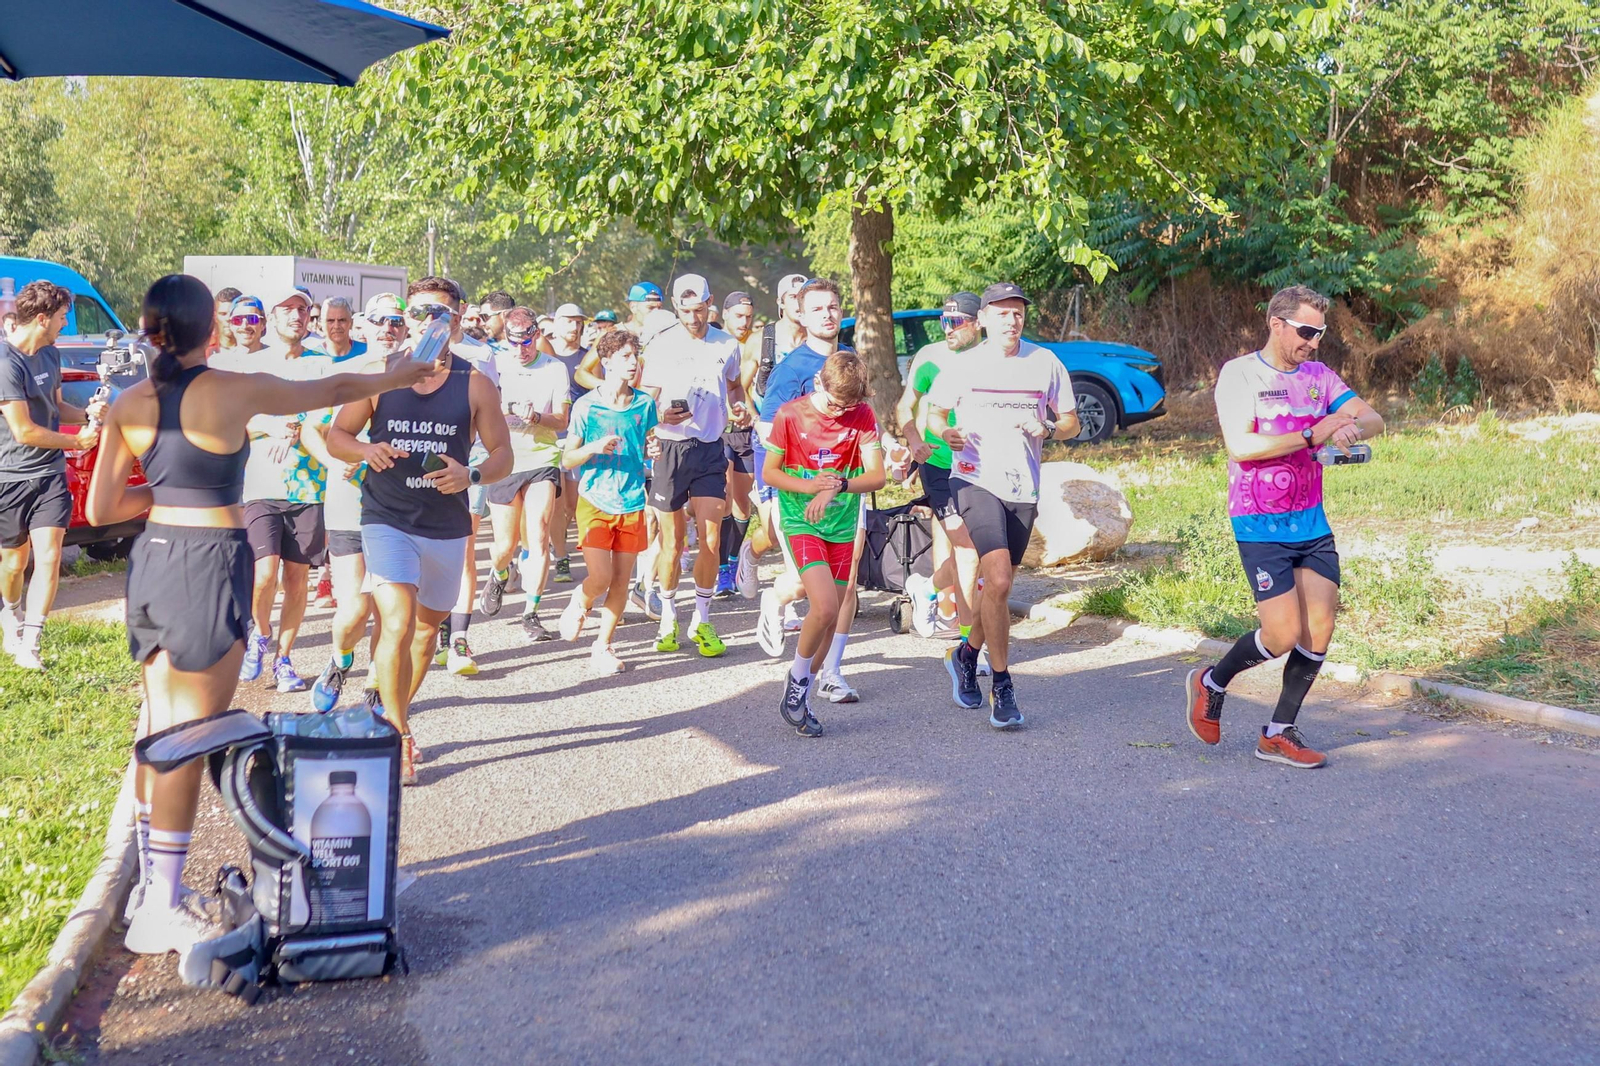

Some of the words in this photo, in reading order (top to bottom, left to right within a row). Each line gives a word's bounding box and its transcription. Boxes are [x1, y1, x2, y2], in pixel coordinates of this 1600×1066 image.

[302, 272, 334, 285] VITAMIN
[335, 275, 355, 286] WELL
[387, 419, 410, 433] POR
[412, 421, 433, 434] LOS
[434, 423, 457, 436] QUE
[312, 837, 353, 850] VITAMIN
[312, 855, 343, 868] SPORT
[343, 854, 361, 867] 001
